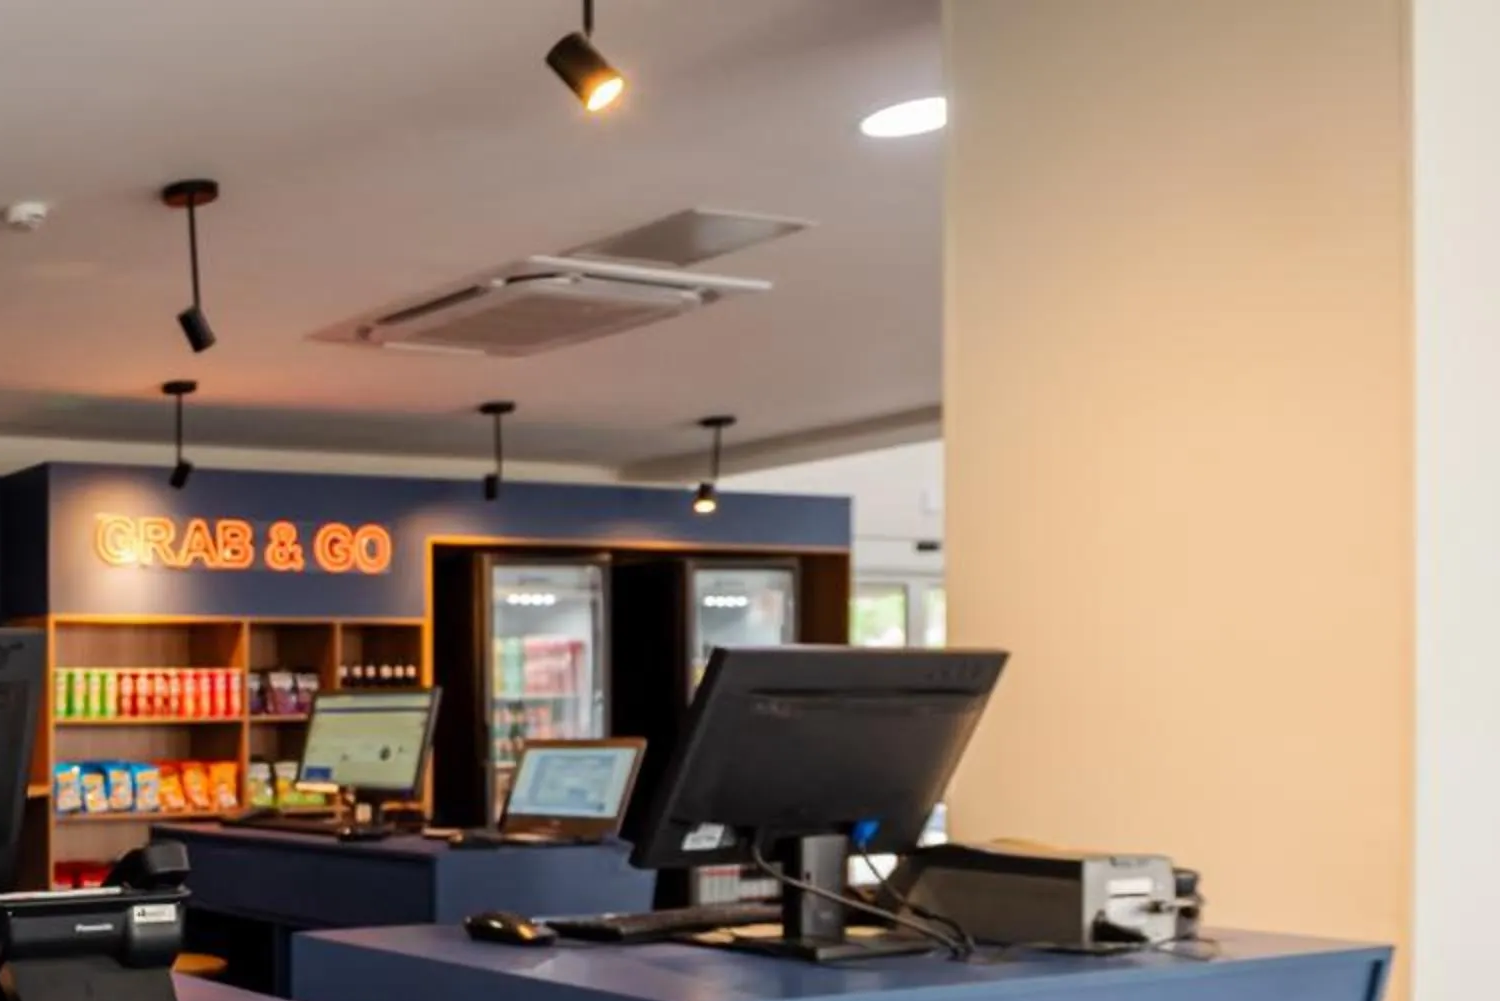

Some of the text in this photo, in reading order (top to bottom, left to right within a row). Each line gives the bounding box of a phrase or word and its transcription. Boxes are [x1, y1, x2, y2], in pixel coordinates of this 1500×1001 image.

[94, 515, 392, 574] GRAB & GO
